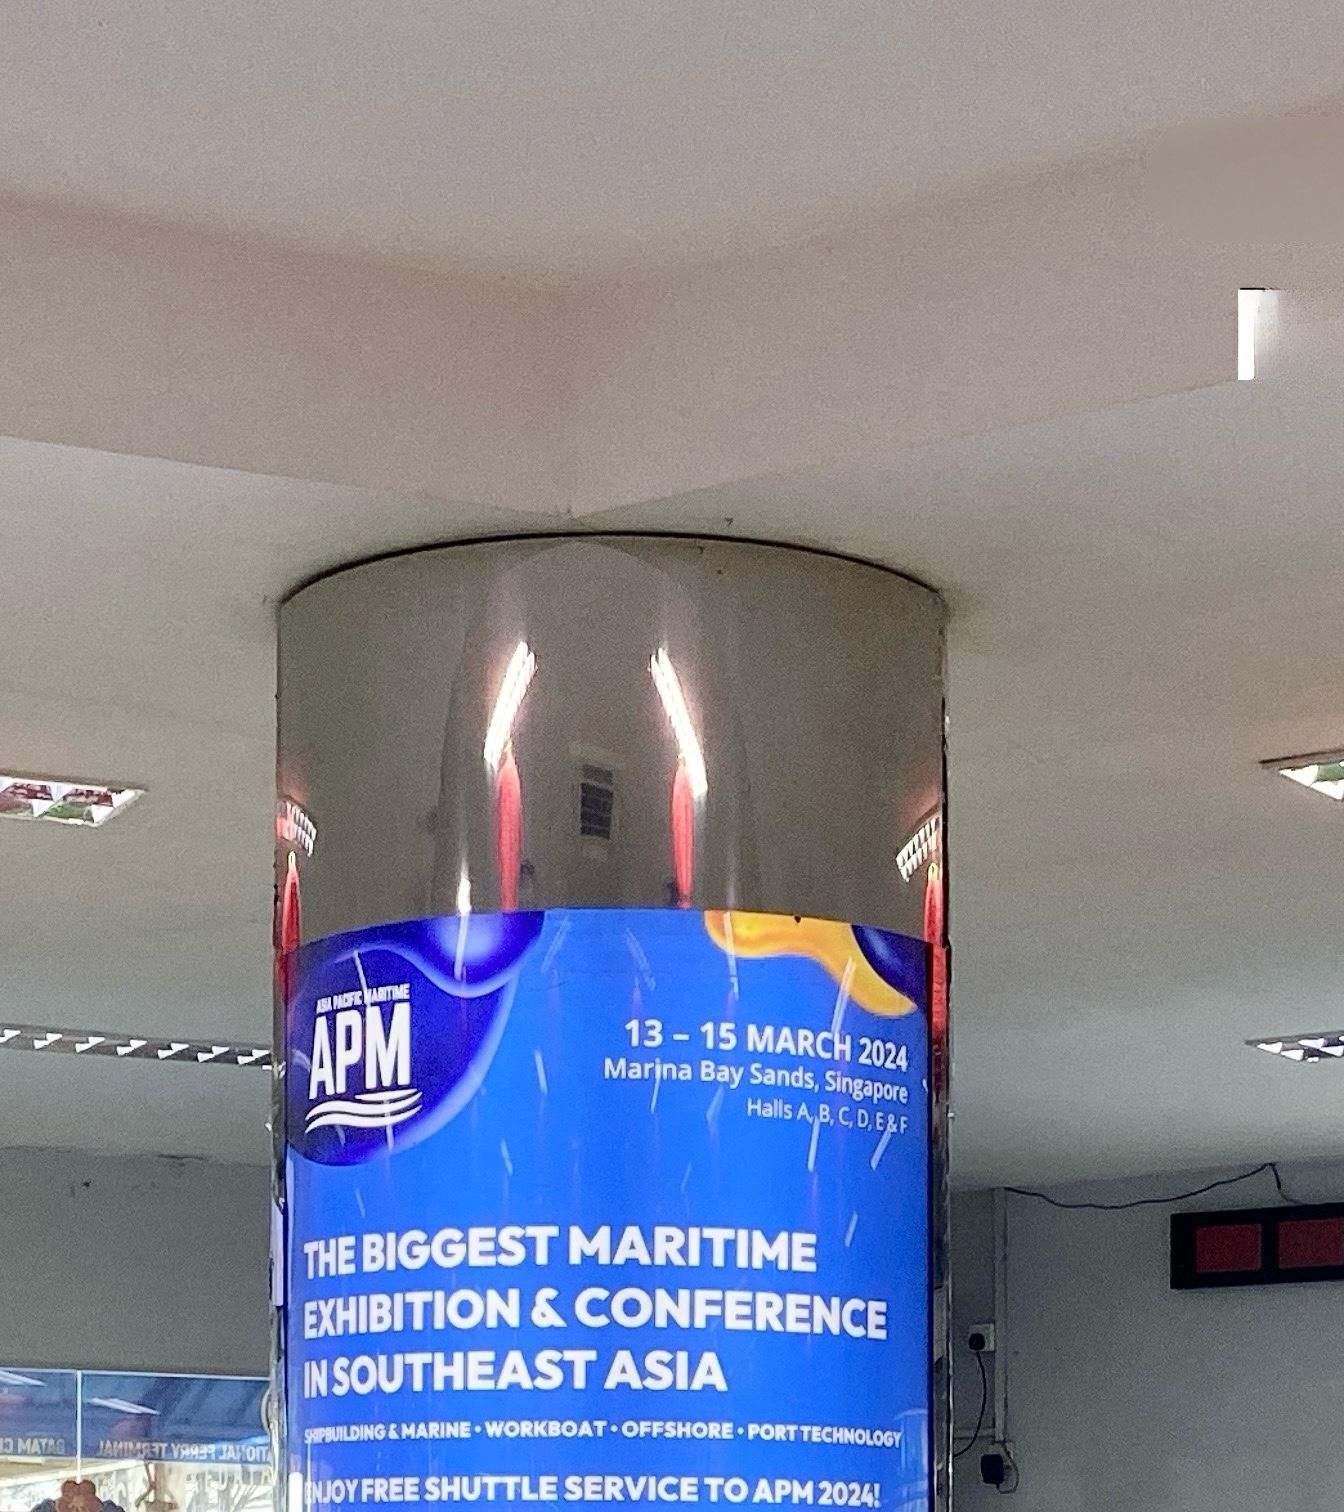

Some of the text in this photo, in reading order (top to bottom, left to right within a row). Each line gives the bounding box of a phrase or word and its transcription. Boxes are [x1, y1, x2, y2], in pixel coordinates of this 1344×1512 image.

[308, 1001, 411, 1100] APM
[624, 1019, 663, 1047] 13
[700, 1021, 737, 1051] 15
[747, 1024, 852, 1062] MARCH
[858, 1037, 909, 1072] 2024
[604, 1057, 908, 1104] Marina Bay Sands, Singapore
[747, 1098, 793, 1120] Halls
[304, 1225, 817, 1280] THE BIGGEST MARITIME
[304, 1287, 888, 1340] EXHIBITION & CONFERENCE
[304, 1349, 728, 1399] IN SOUTHEAST ASIA
[402, 1421, 471, 1439] MARINE
[484, 1420, 607, 1438] WORKBOAT
[622, 1420, 735, 1440] OFFSHORE
[305, 1478, 358, 1505] ENJOY
[361, 1477, 420, 1503] FREE
[424, 1475, 558, 1502] SHUTTLE
[564, 1476, 699, 1502] SERVICE
[704, 1477, 749, 1503] TO
[752, 1478, 814, 1504] APM
[818, 1481, 881, 1508] 2024!
